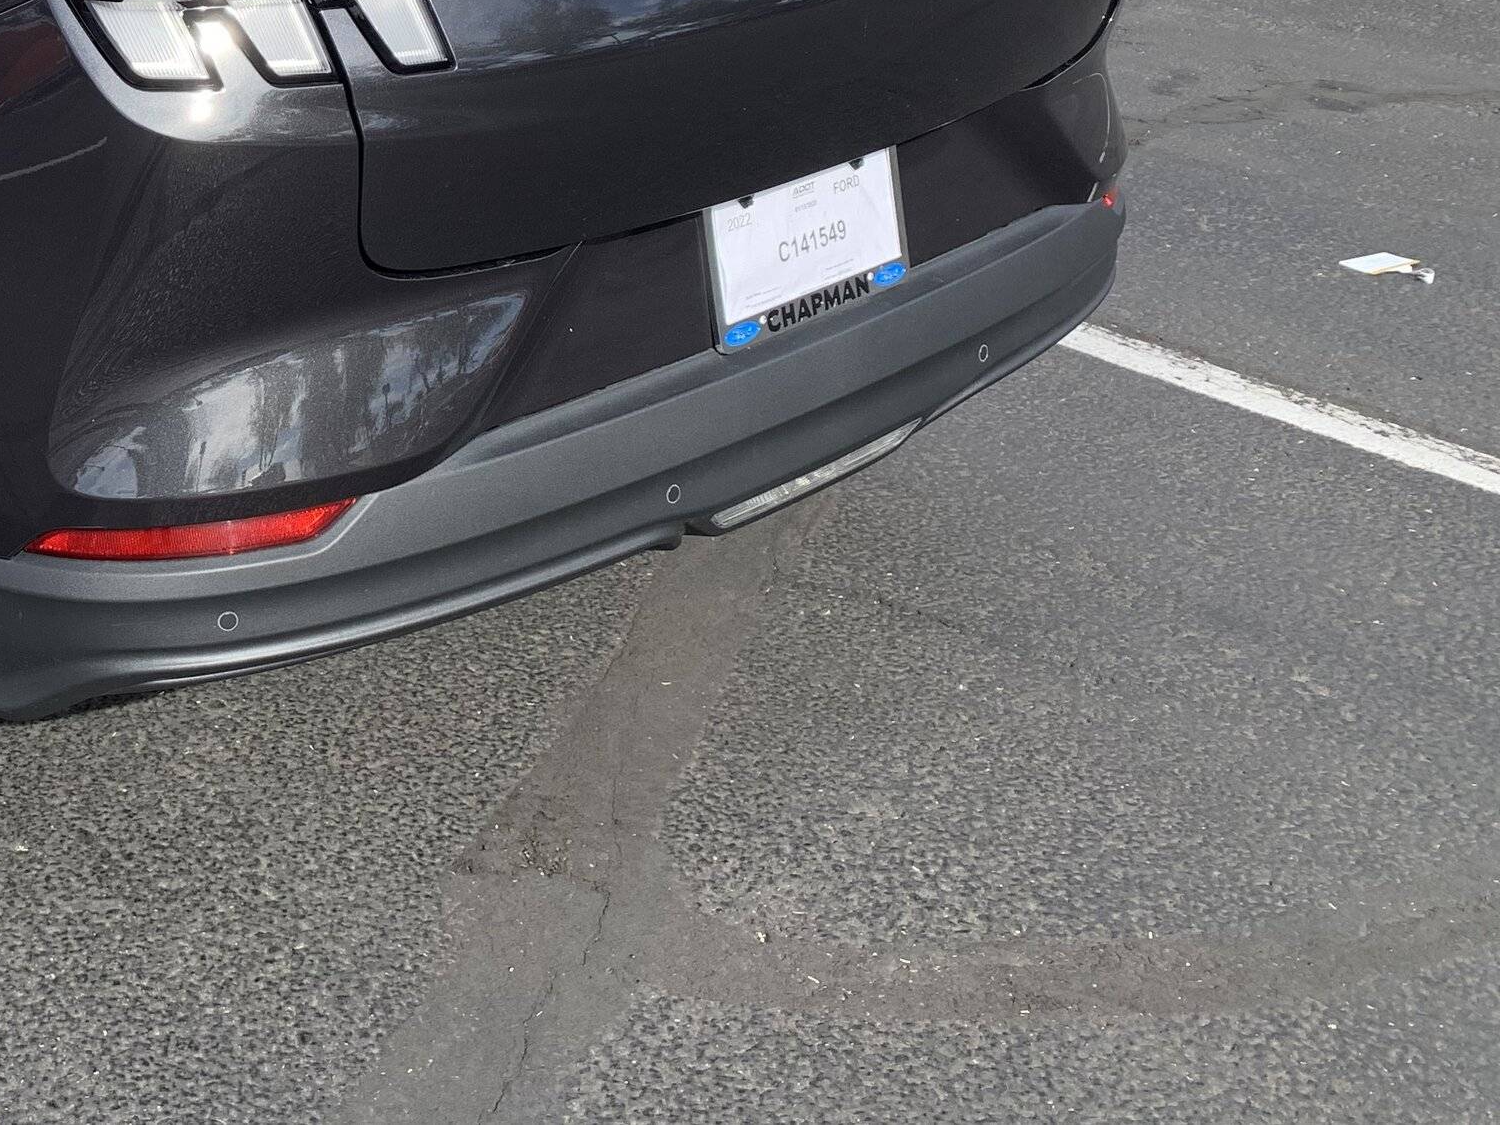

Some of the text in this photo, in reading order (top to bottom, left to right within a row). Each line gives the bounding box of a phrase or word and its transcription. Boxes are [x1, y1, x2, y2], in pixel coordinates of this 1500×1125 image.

[833, 175, 859, 194] FORD
[727, 212, 752, 232] 2022
[778, 220, 846, 262] C141549
[767, 274, 870, 332] CHAPMAN
